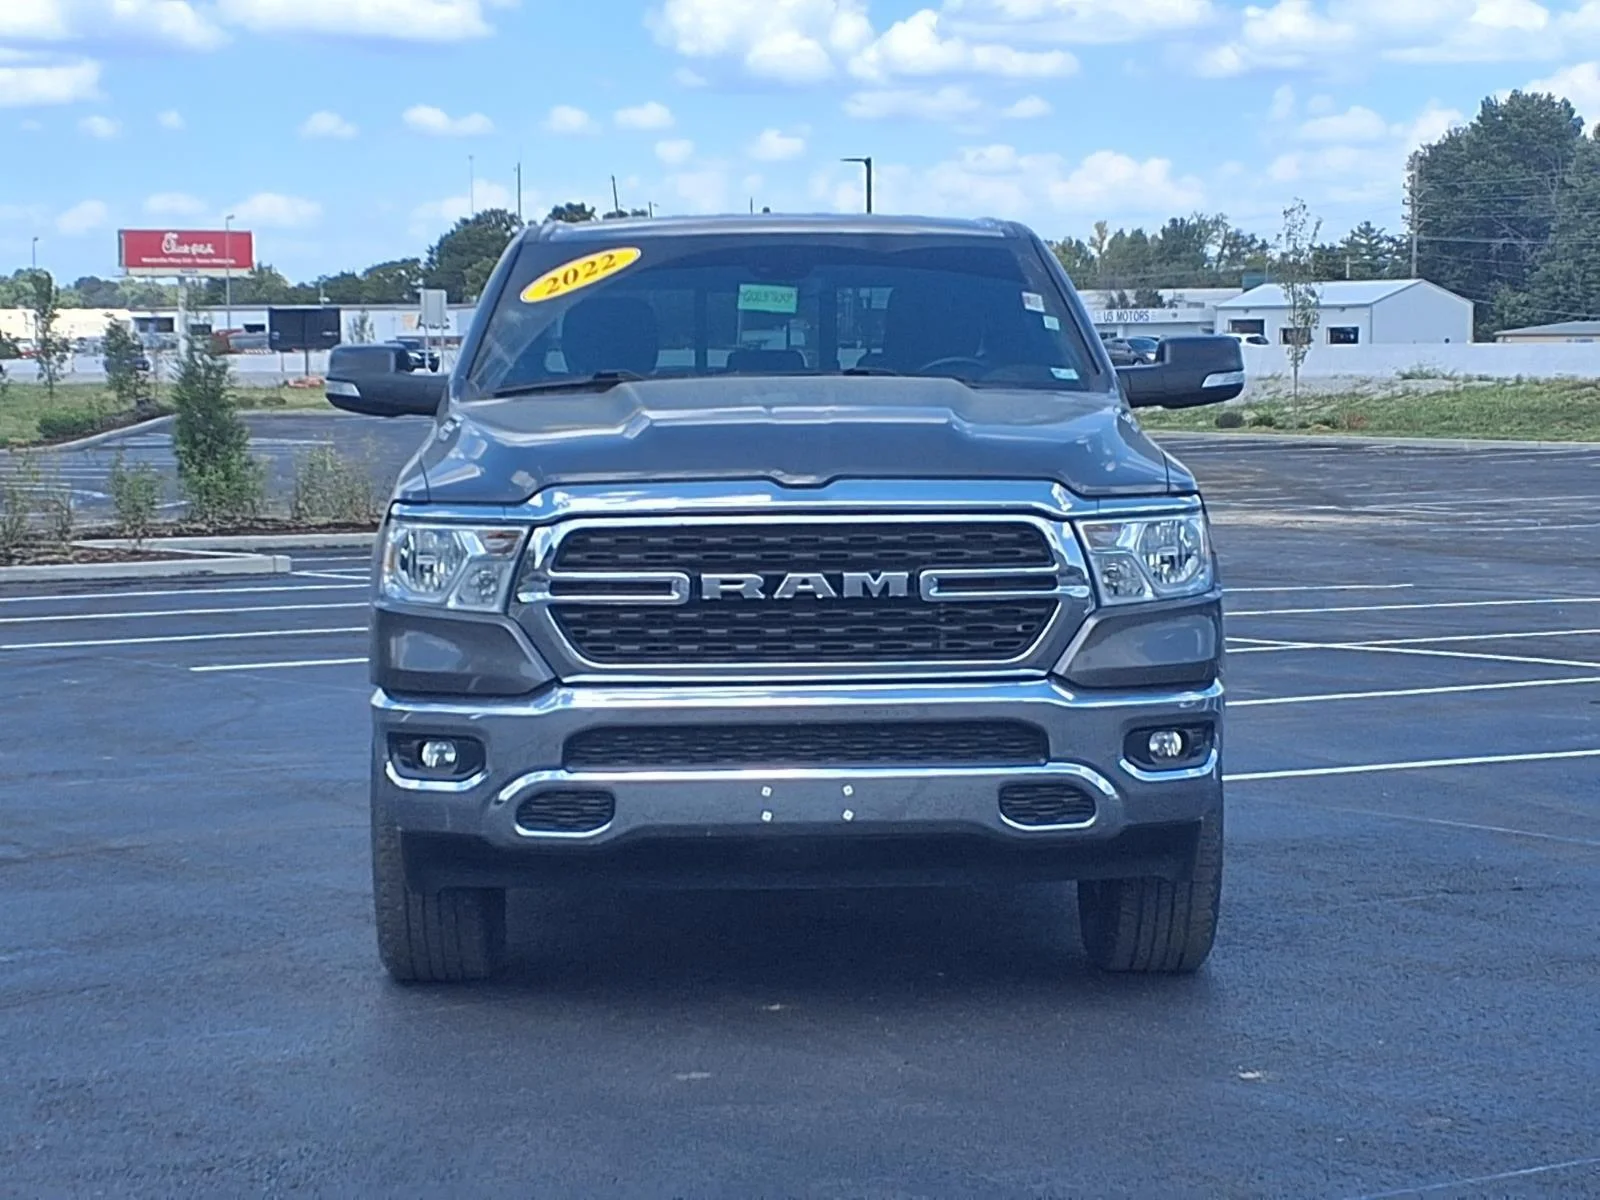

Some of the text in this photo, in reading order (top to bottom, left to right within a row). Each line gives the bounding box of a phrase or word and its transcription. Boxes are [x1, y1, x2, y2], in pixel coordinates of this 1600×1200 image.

[543, 253, 617, 295] 2022
[1103, 310, 1150, 322] US MOTORS
[701, 572, 909, 599] RAM
